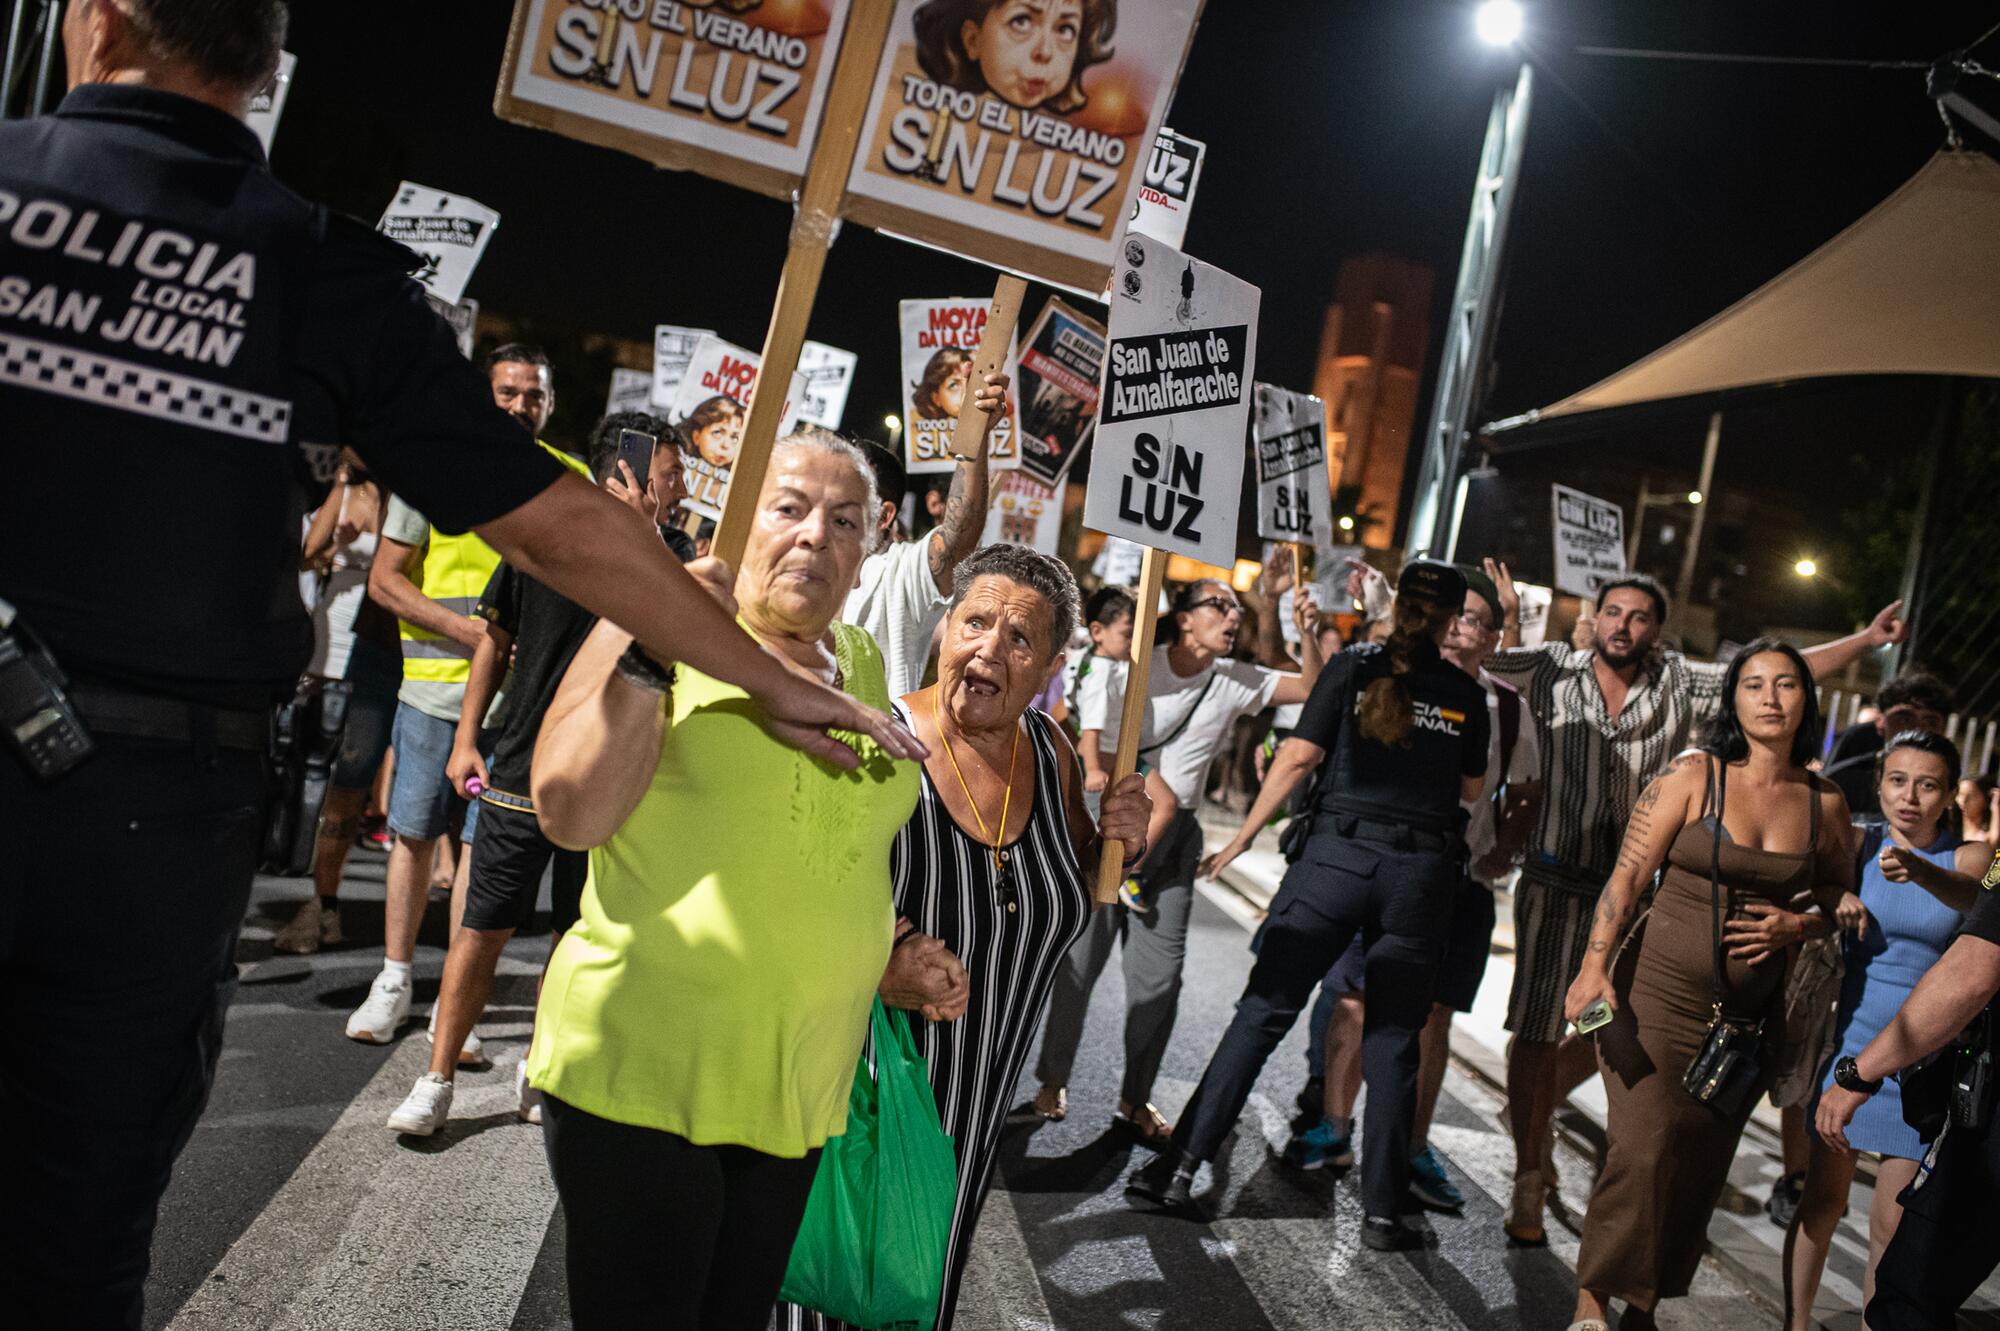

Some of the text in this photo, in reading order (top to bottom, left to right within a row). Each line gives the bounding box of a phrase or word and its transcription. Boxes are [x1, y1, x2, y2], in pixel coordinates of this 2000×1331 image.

[692, 8, 807, 68] VERANO
[669, 40, 801, 136] LUZ
[904, 75, 1126, 167] TODO EL VERANO
[992, 139, 1119, 230] LUZ
[1146, 147, 1191, 193] UZ
[0, 276, 244, 368] SAN JUAN
[131, 279, 246, 328] LOCAL
[918, 331, 938, 348] DA
[941, 330, 961, 347] LA
[1112, 331, 1230, 377] San Juan de
[718, 354, 759, 385] MO
[1112, 366, 1240, 417] Aznalfarache
[1118, 474, 1205, 544] LUZ
[1274, 506, 1313, 536] LUZ
